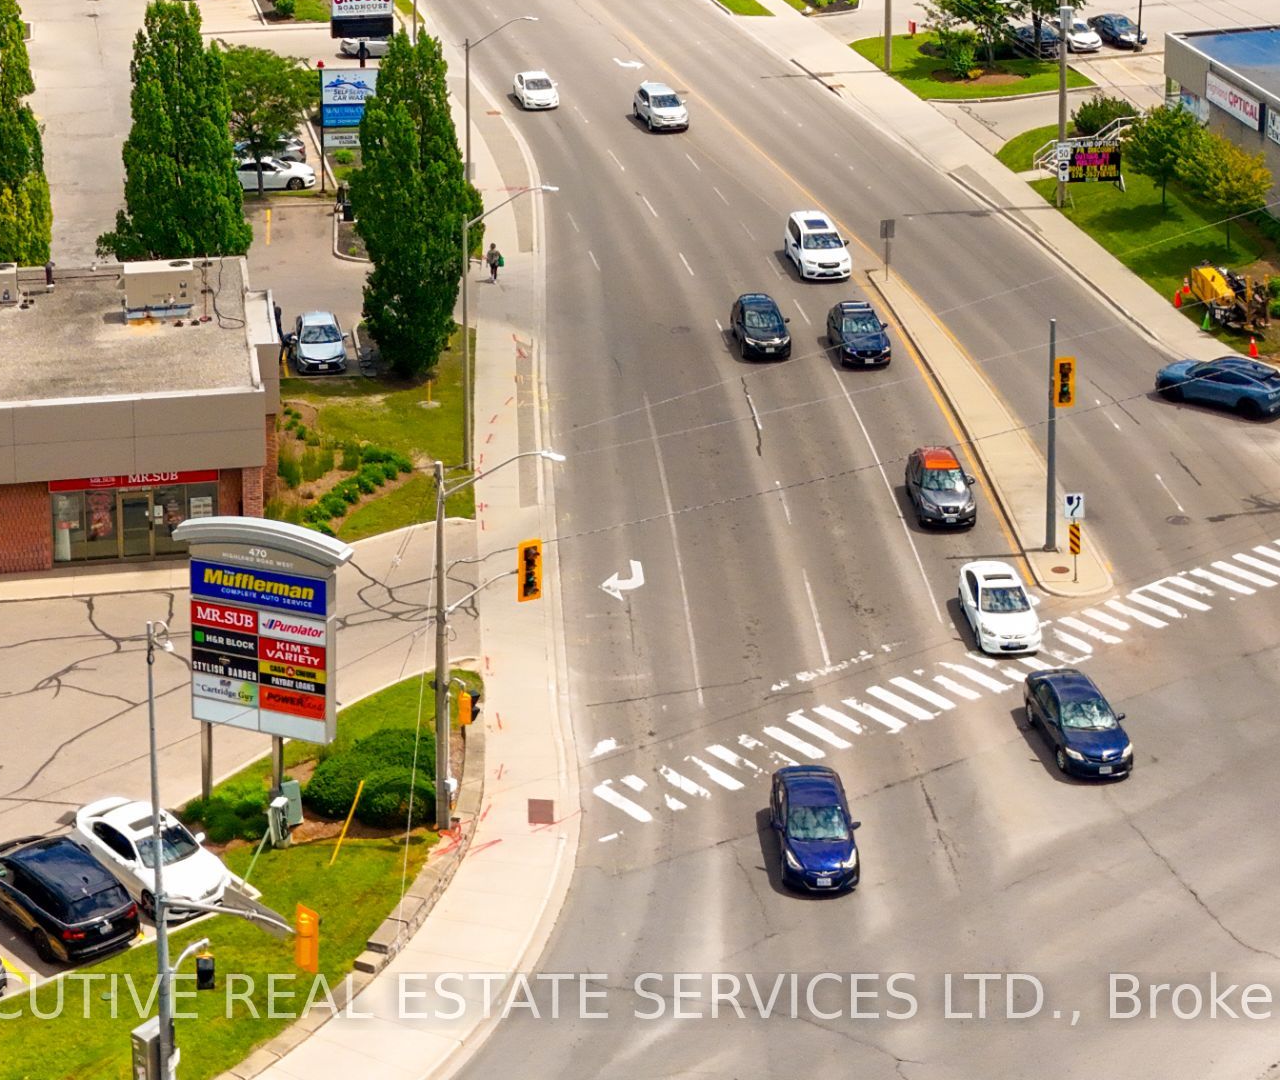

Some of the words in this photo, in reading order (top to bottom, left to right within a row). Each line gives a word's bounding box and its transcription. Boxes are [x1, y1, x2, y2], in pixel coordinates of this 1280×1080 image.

[337, 3, 388, 11] ROADHOUSE
[1228, 91, 1258, 121] OPTICAL
[1059, 149, 1069, 158] 50
[128, 472, 179, 483] MR.SUB
[222, 552, 254, 563] HIGHLAND
[256, 557, 274, 566] ROAD
[248, 548, 267, 558] 470
[203, 568, 315, 601] Mufflerman
[221, 587, 257, 599] COMPLETE
[261, 593, 279, 602] AUTO
[282, 597, 313, 608] SERVICE
[196, 606, 254, 628] MR.SUB
[272, 620, 324, 638] Purolator
[206, 634, 224, 645] H&R
[225, 638, 255, 650] BLOCK
[276, 641, 310, 654] KIM'S
[265, 649, 320, 666] VARIETY
[193, 660, 224, 675] STYLISH
[228, 667, 257, 681] BARBER
[201, 684, 237, 698] Cartridge
[238, 690, 254, 702] Guy
